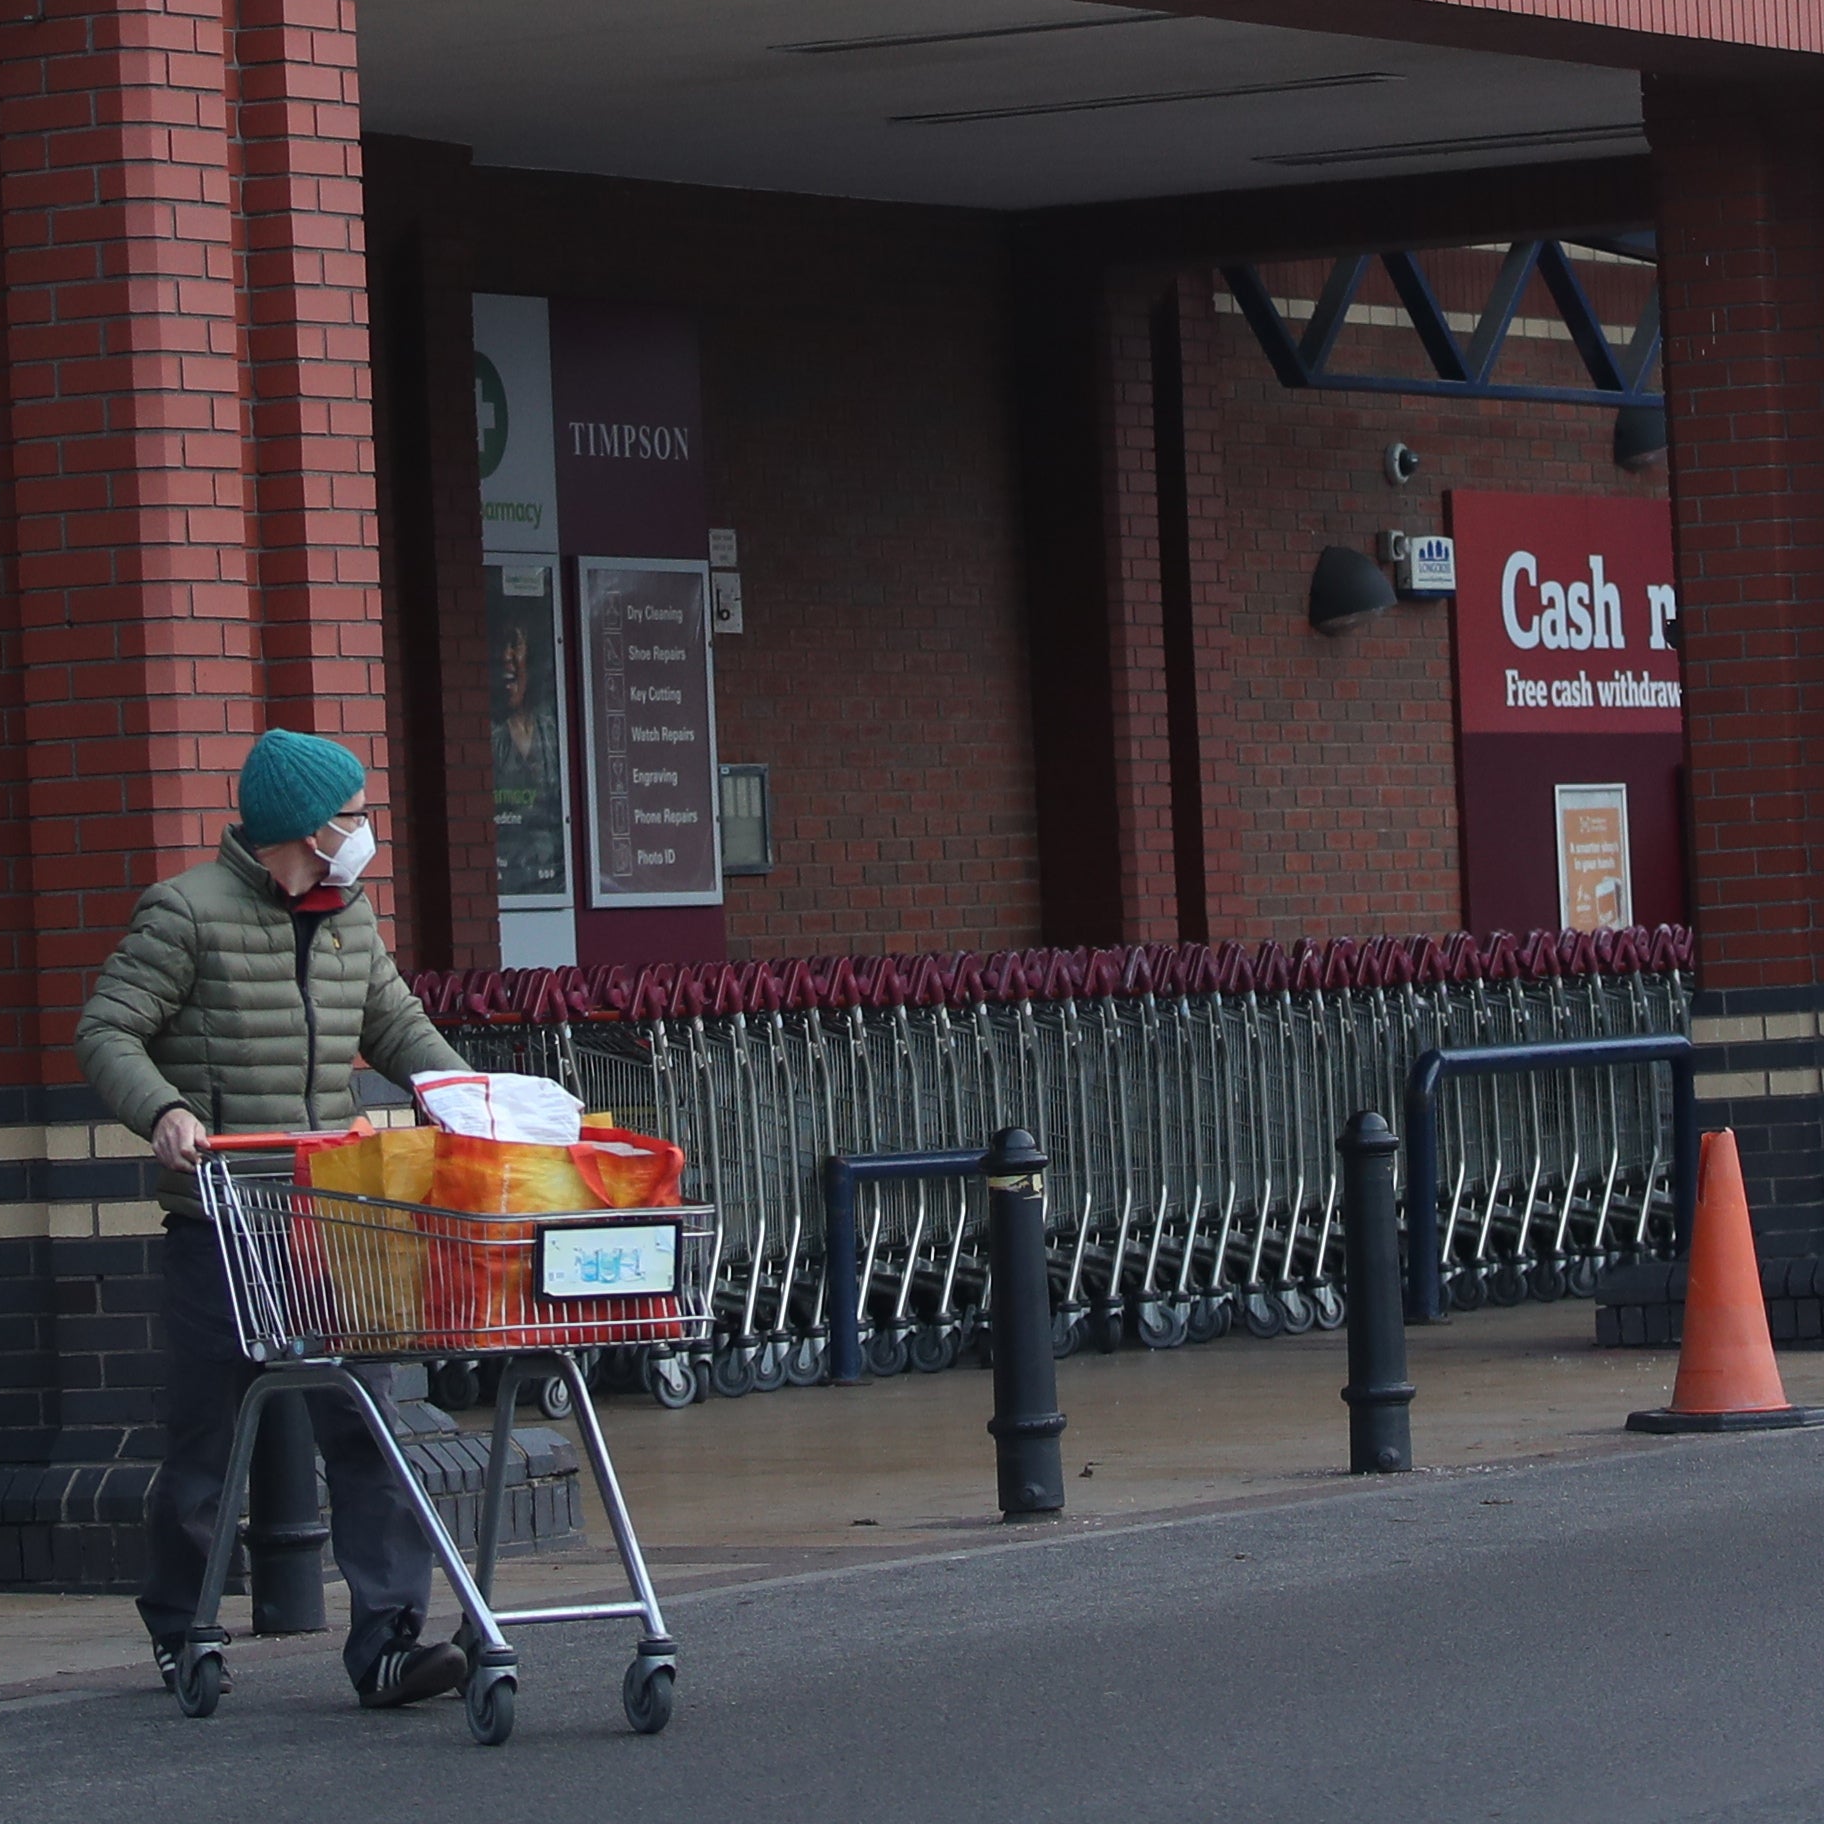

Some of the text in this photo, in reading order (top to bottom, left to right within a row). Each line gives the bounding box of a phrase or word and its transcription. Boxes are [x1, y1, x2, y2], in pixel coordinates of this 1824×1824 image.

[569, 422, 688, 461] TIMPSON
[1501, 550, 1625, 651] Cash
[627, 604, 684, 624] Dry Cleaning
[629, 645, 687, 664] Shoe Repairs
[630, 686, 682, 704] Key Cutting
[1505, 669, 1547, 707] Free
[1551, 670, 1594, 707] cash
[631, 727, 695, 745] Watch Repairs
[633, 768, 678, 786] Engraving
[634, 808, 698, 826] Phone Repairs
[637, 849, 676, 865] Photo ID
